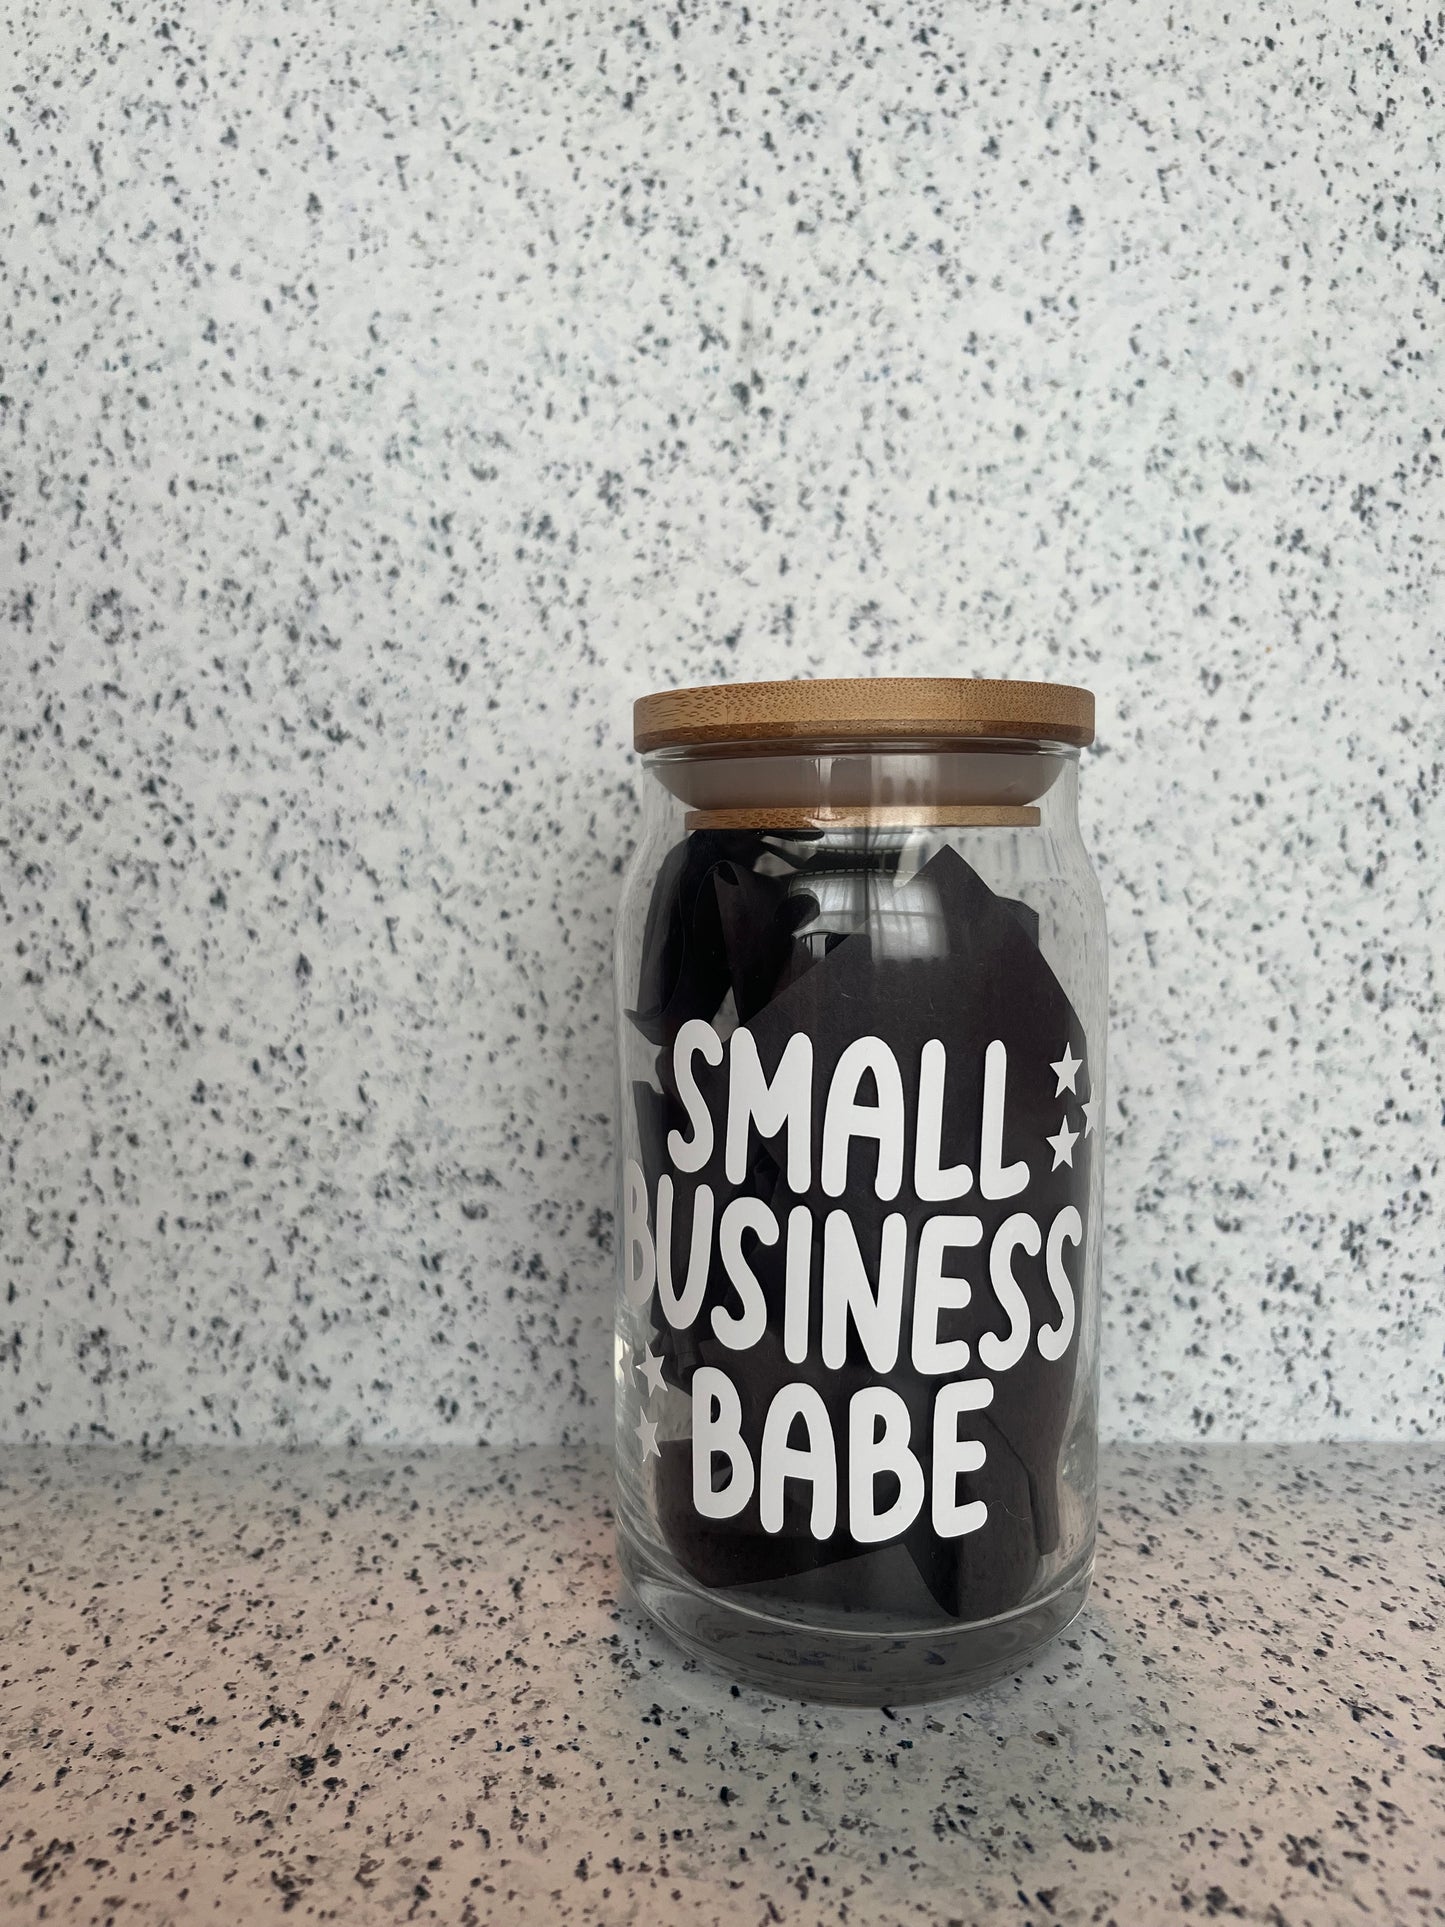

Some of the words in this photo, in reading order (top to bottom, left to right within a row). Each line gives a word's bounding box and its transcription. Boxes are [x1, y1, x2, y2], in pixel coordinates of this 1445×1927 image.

[667, 1019, 1030, 1201] SMALL
[624, 1159, 1082, 1375] BUSINESS
[692, 1367, 994, 1543] BABE
